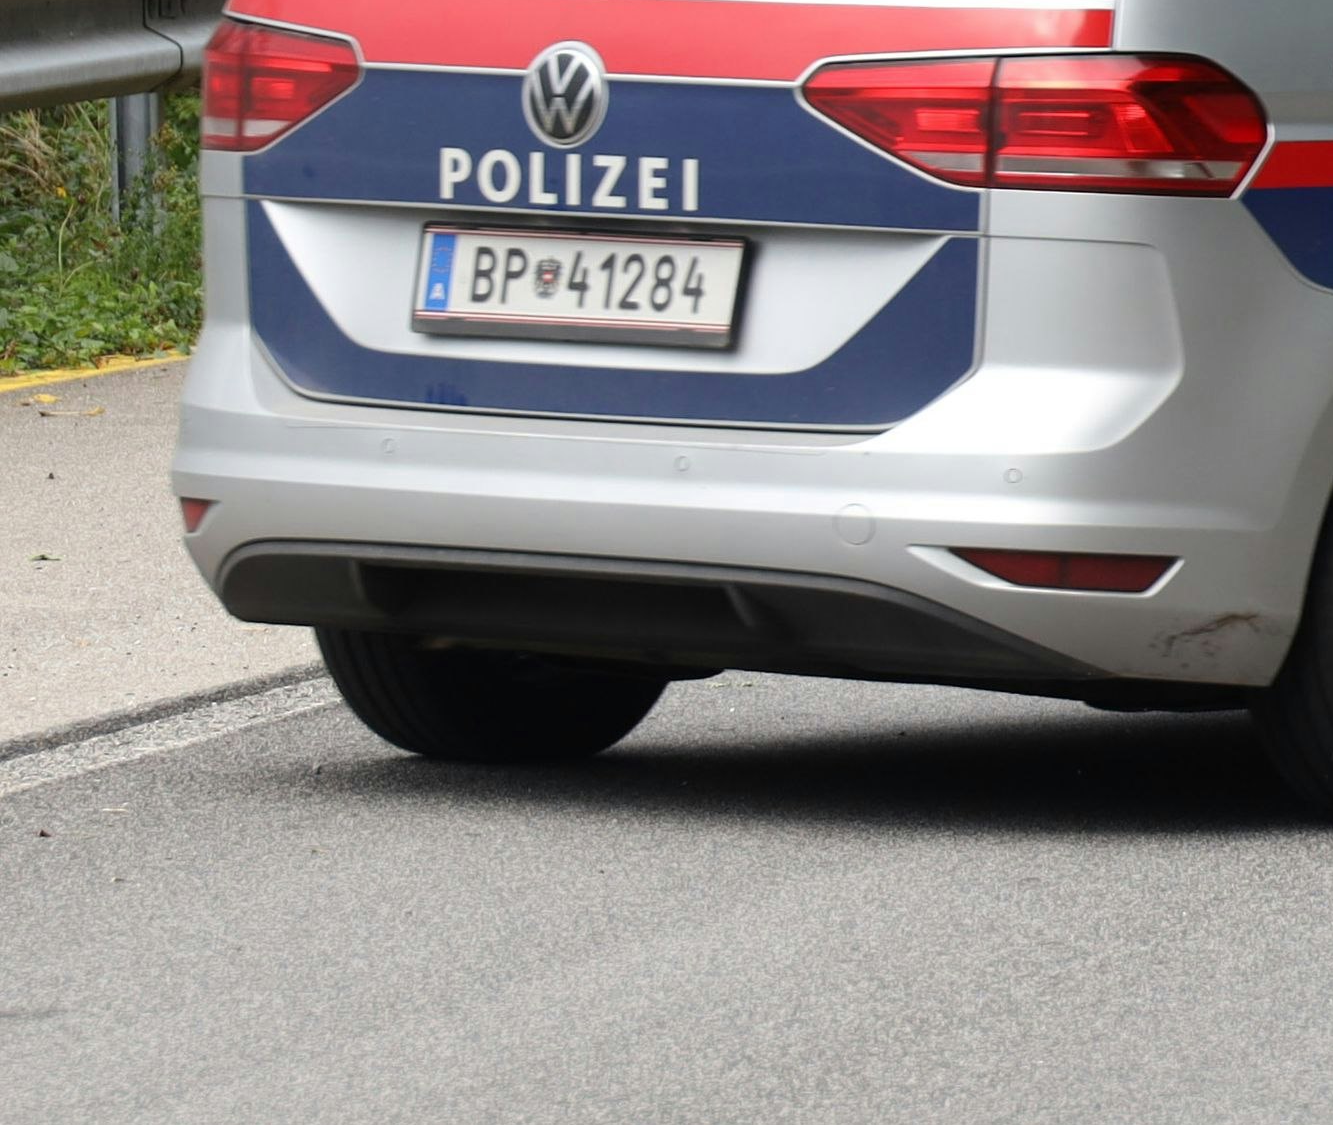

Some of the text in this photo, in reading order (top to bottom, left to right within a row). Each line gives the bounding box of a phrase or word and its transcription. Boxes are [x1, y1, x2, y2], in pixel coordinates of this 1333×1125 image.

[439, 146, 699, 212] POLIZEI
[470, 246, 704, 314] BP 41284
